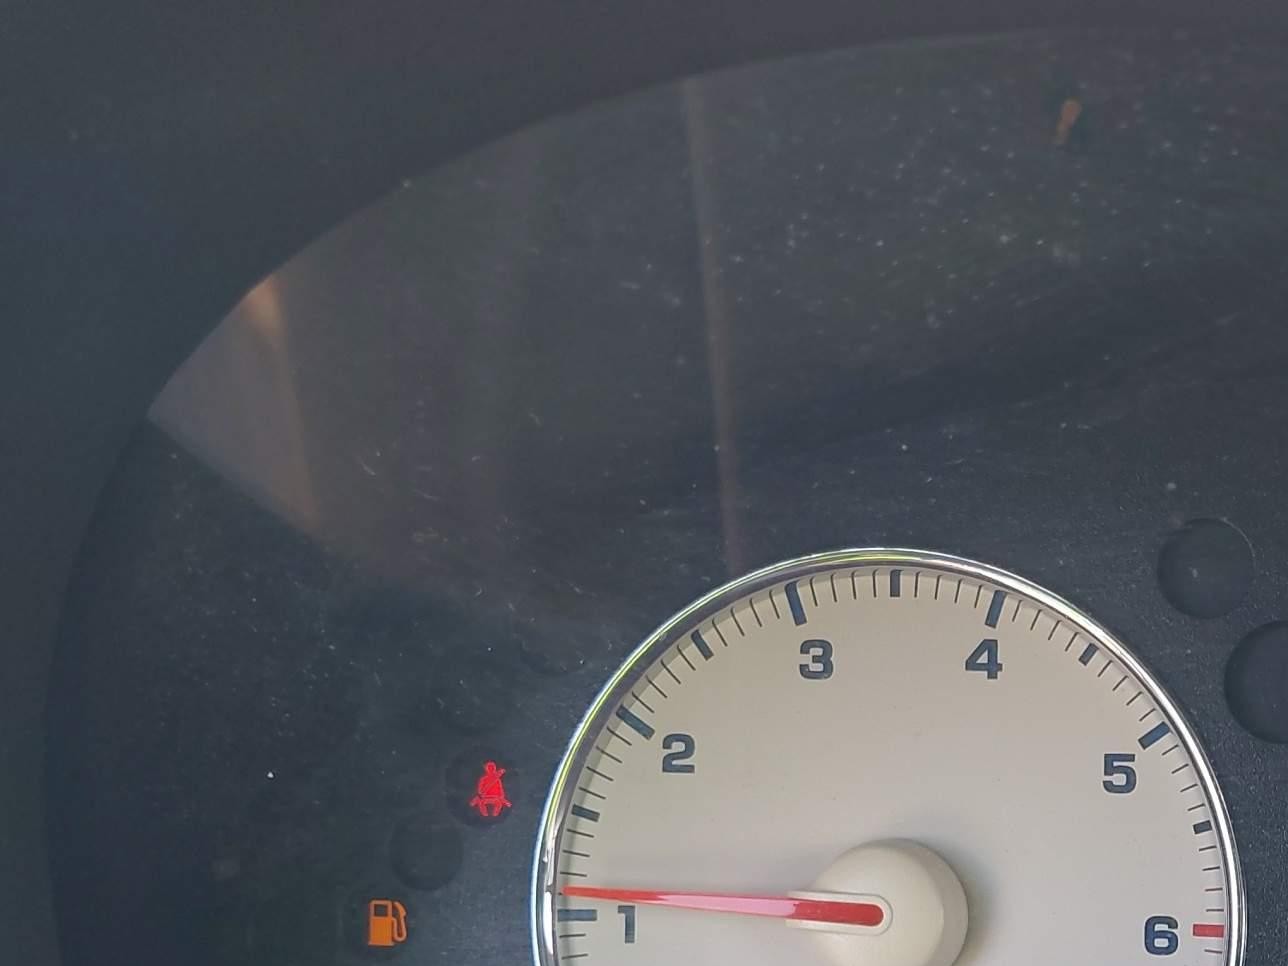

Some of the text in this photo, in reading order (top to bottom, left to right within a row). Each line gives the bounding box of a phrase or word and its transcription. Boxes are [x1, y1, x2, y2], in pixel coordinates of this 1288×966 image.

[798, 638, 834, 680] 3
[964, 638, 1004, 680] 4
[661, 733, 696, 774] 2
[1102, 753, 1137, 795] 5
[614, 905, 638, 944] 1
[1142, 916, 1181, 956] 6
